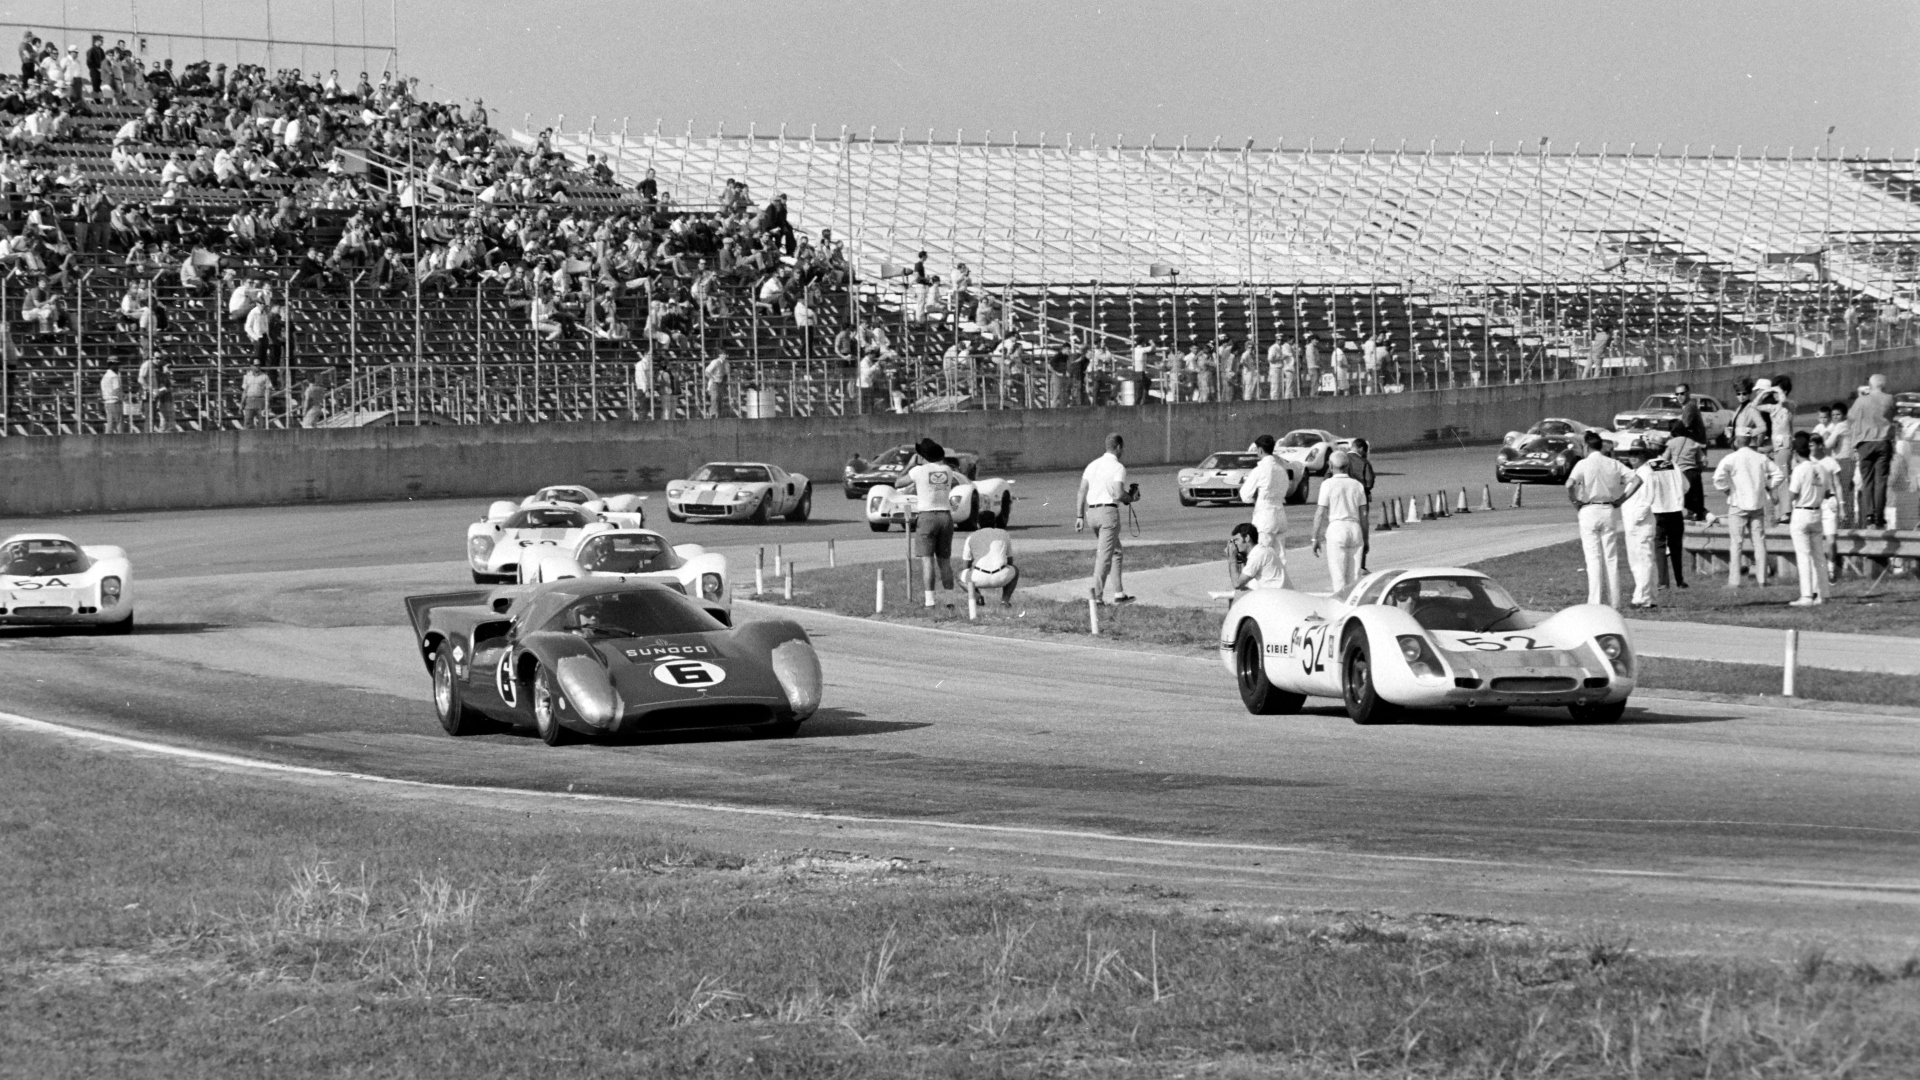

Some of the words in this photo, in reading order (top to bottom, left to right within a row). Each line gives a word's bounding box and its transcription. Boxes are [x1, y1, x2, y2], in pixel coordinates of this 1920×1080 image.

[12, 577, 70, 590] 54
[625, 645, 708, 657] SUNOCO
[1266, 644, 1289, 654] CIBIE
[1302, 624, 1330, 675] 52
[1456, 635, 1555, 652] 52
[501, 651, 516, 703] 6
[664, 662, 714, 685] 6
